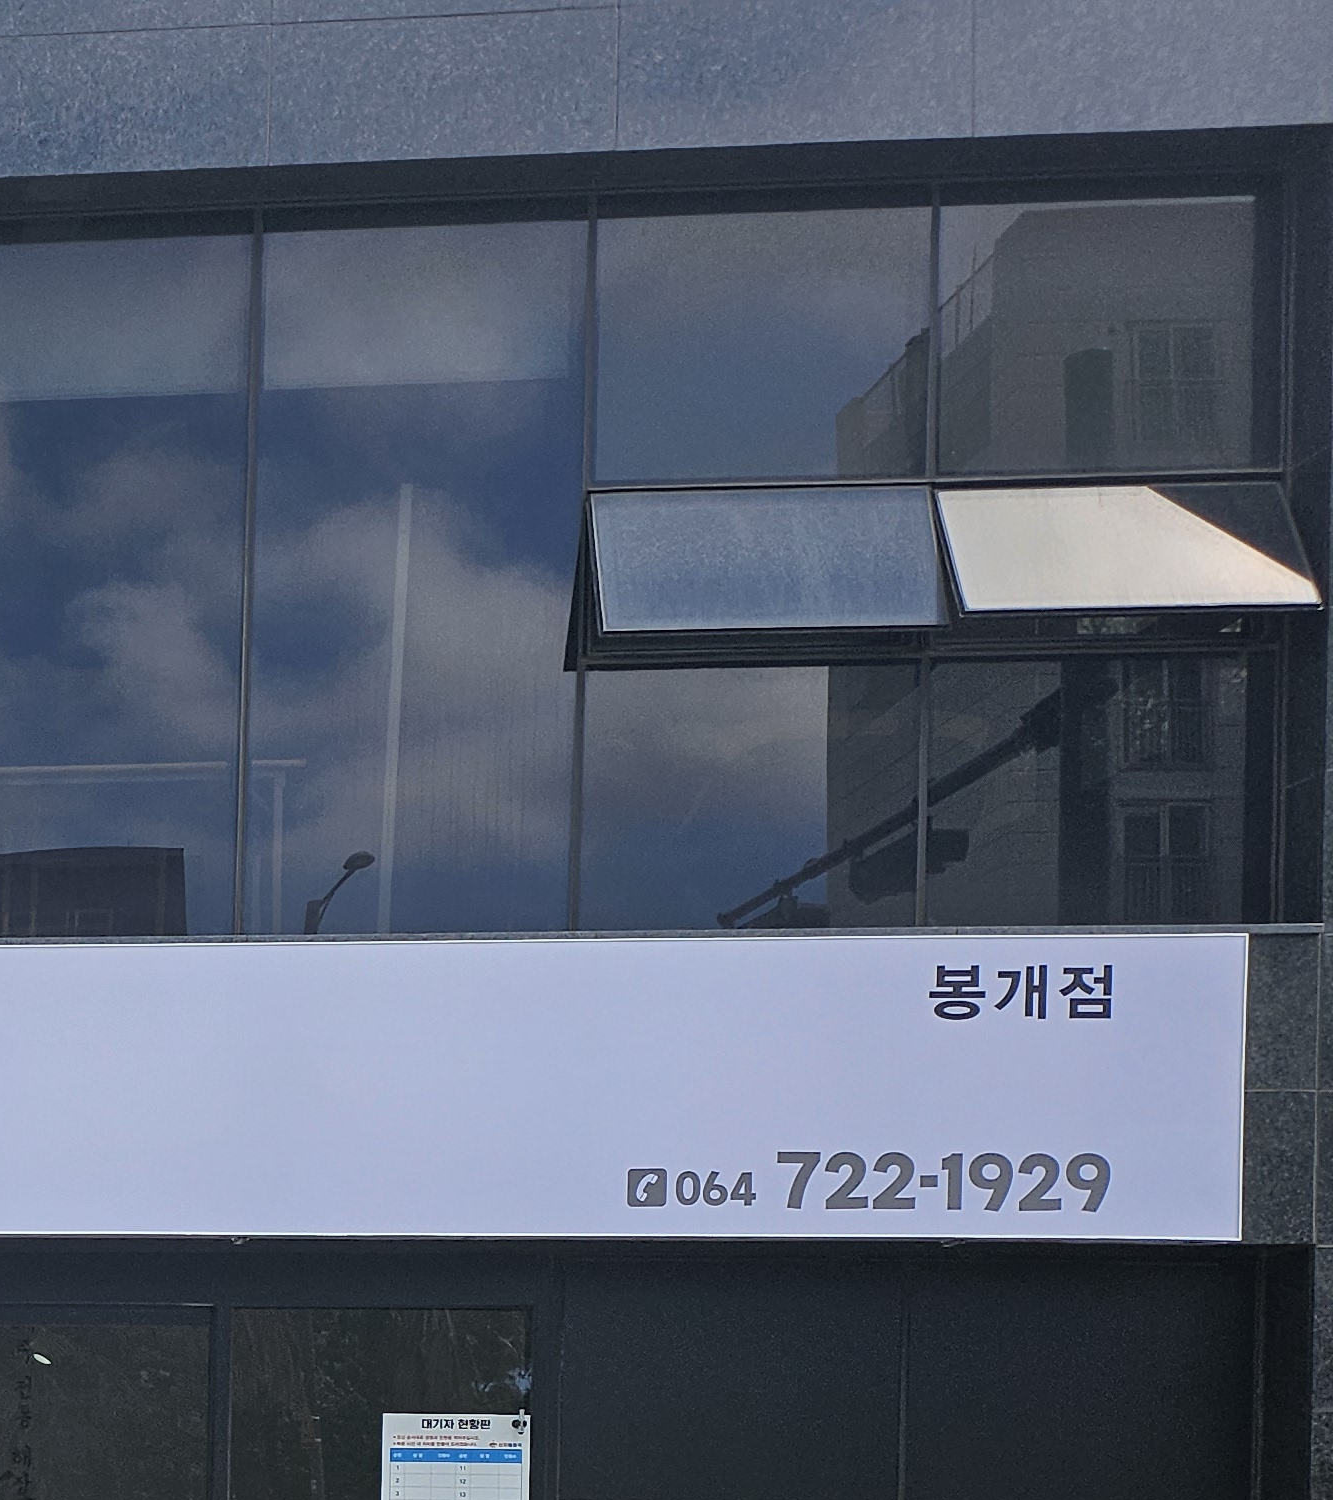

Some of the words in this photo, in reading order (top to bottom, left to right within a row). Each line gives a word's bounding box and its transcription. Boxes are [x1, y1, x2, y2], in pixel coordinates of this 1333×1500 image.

[929, 964, 1115, 1020] 봉개점
[675, 1170, 757, 1207] 064
[776, 1152, 1112, 1213] 722-1929
[421, 1418, 455, 1429] 대기자
[457, 1418, 491, 1430] 현황판
